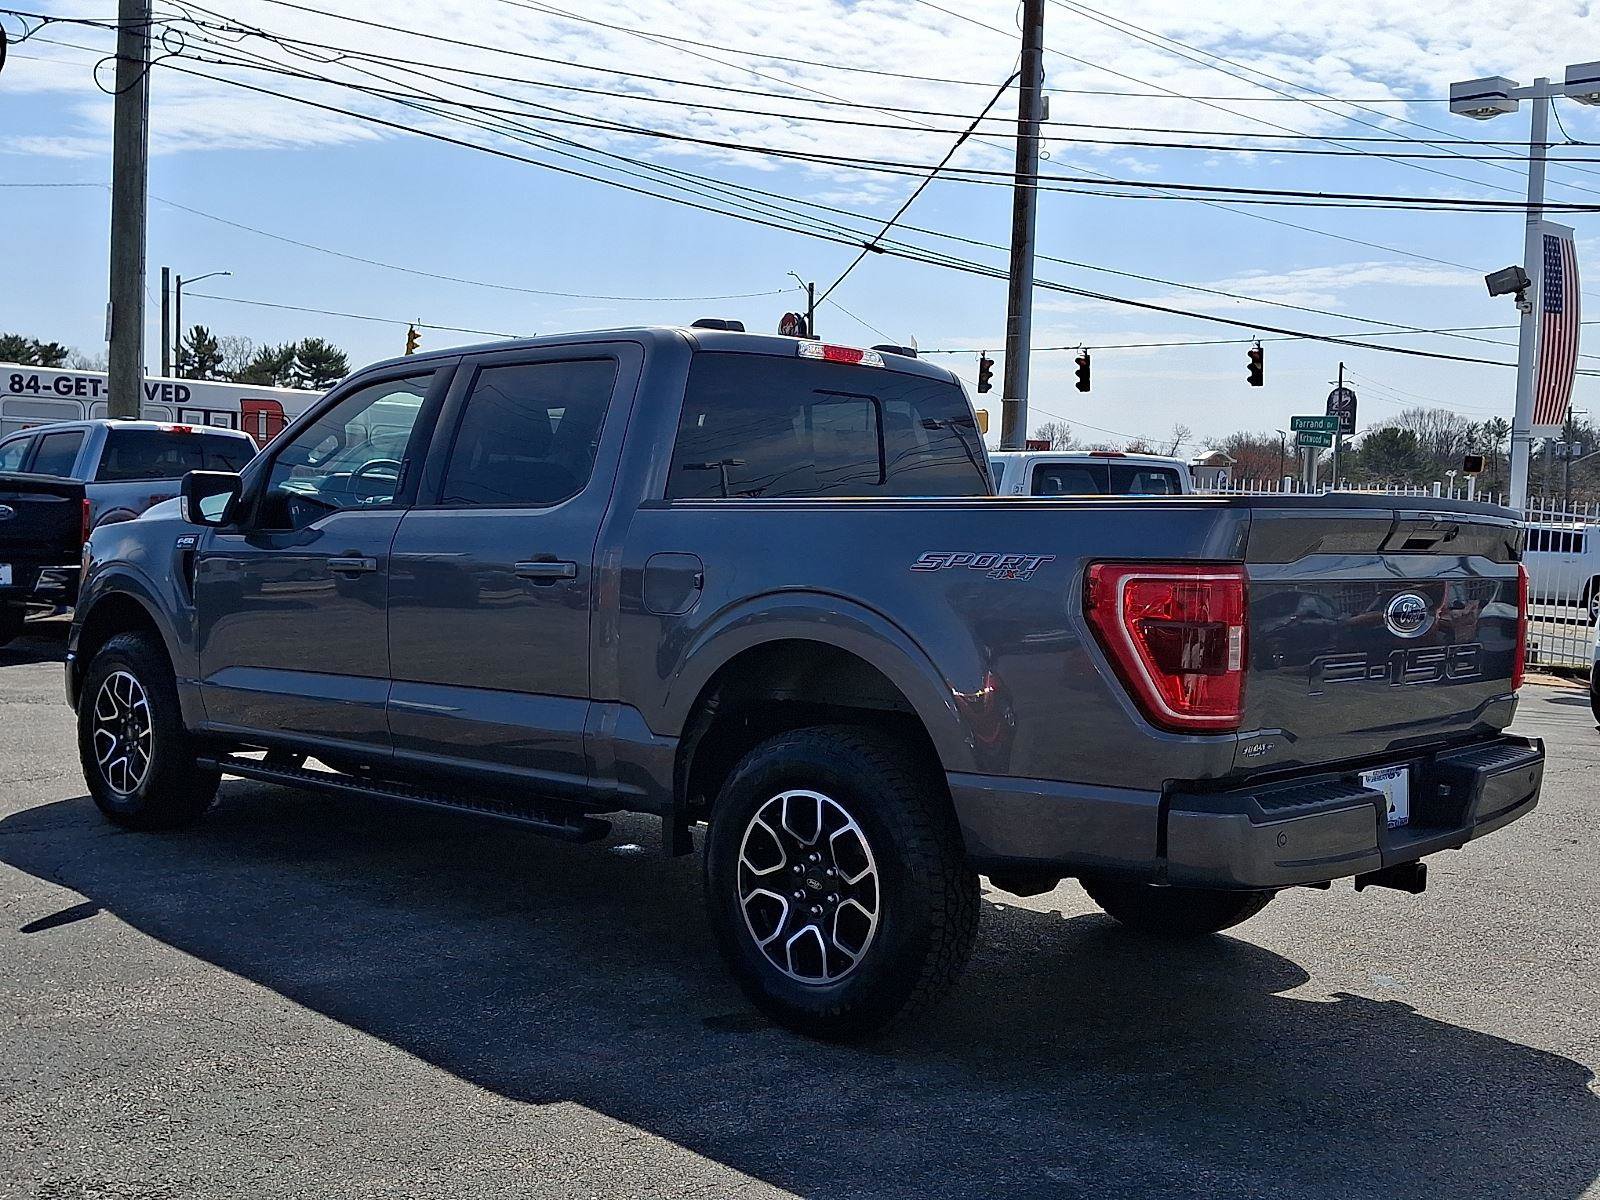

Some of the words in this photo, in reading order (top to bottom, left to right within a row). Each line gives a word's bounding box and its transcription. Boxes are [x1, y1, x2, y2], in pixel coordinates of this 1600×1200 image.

[1295, 419, 1324, 429] Farrand
[910, 551, 1057, 572] SPORT
[1308, 642, 1484, 696] F-150
